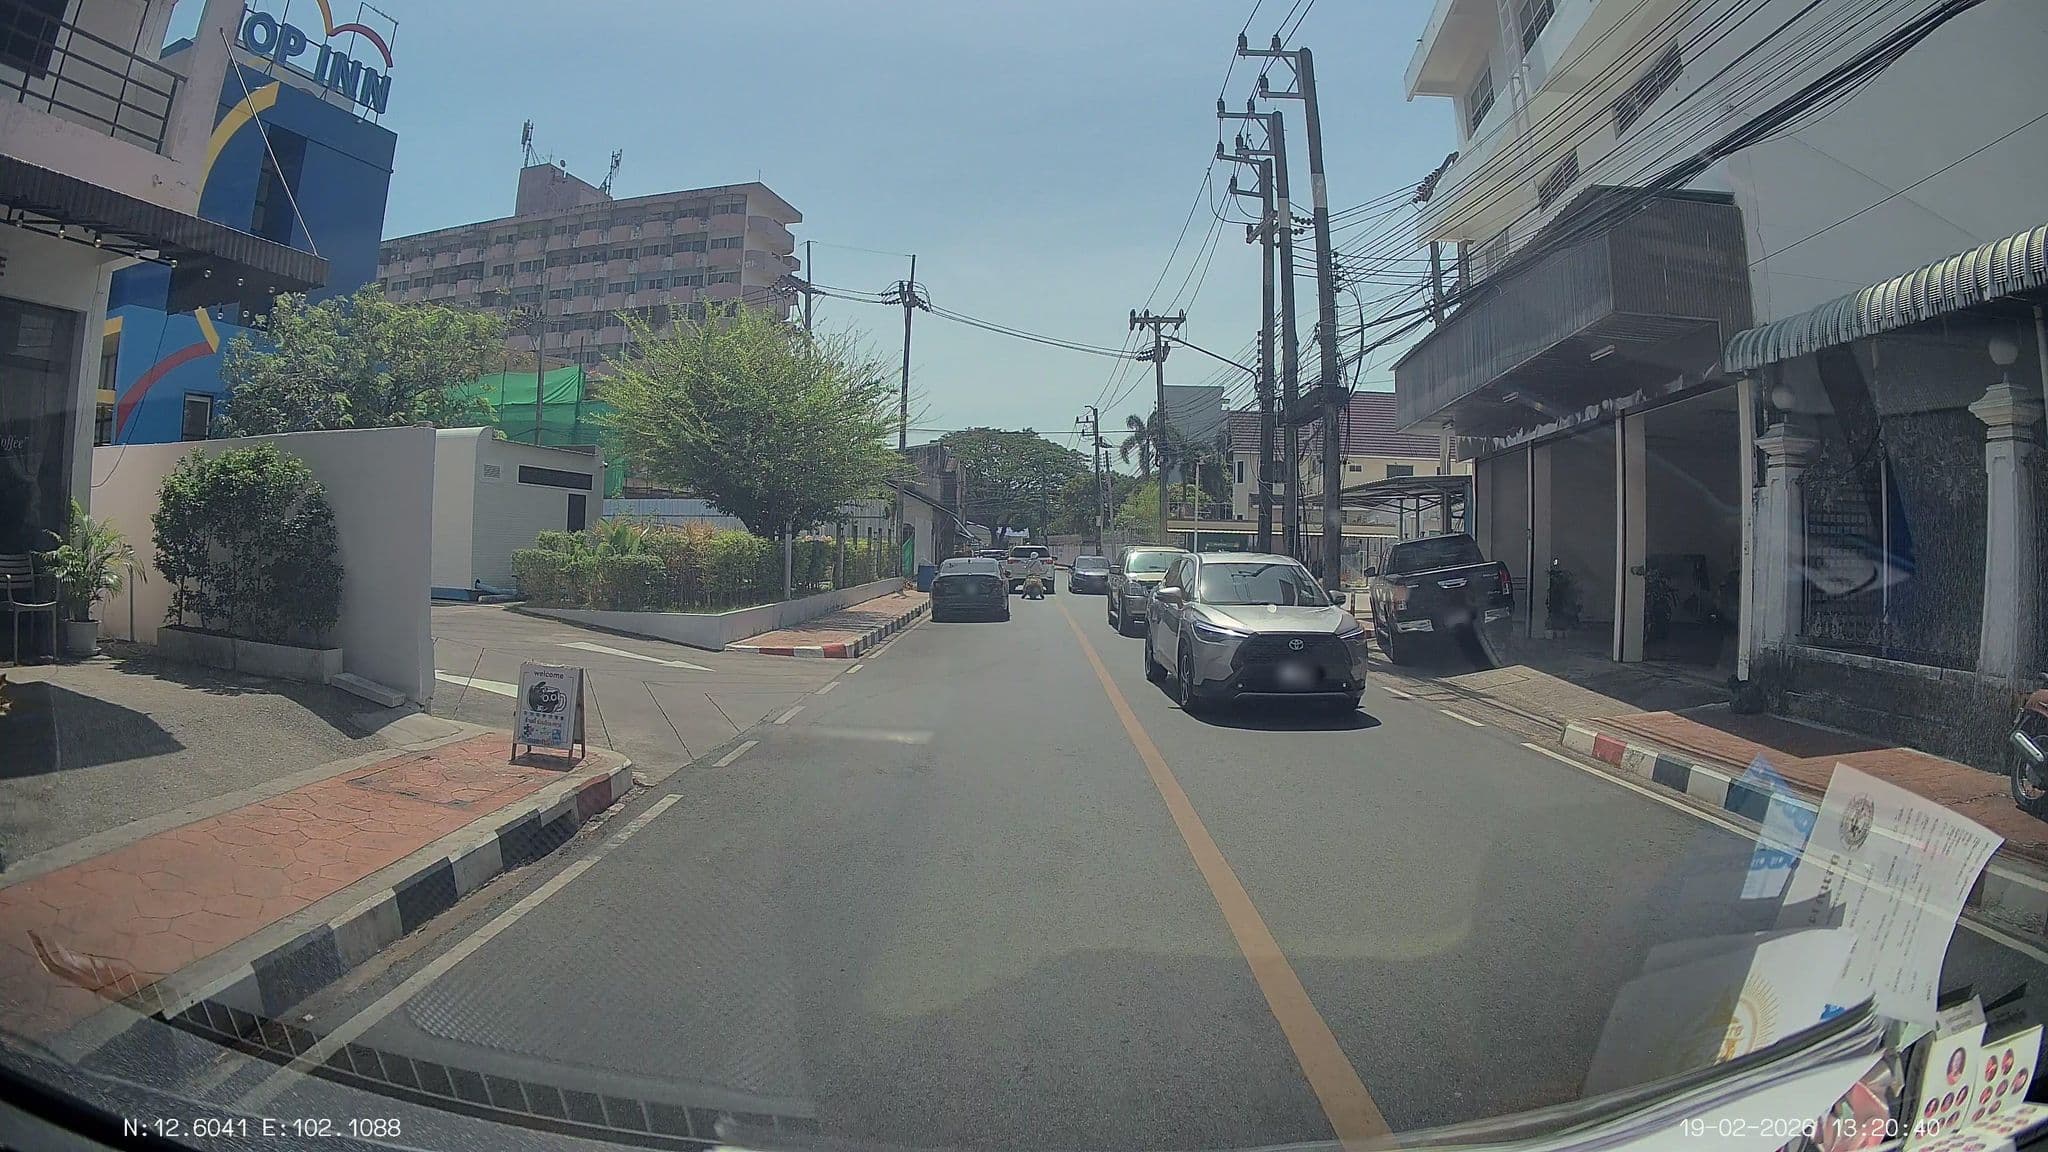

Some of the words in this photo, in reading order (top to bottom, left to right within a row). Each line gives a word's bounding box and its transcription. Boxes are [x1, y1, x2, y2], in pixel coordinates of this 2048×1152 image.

[236, 3, 307, 66] OP
[314, 44, 392, 114] INN
[533, 669, 564, 680] welcome
